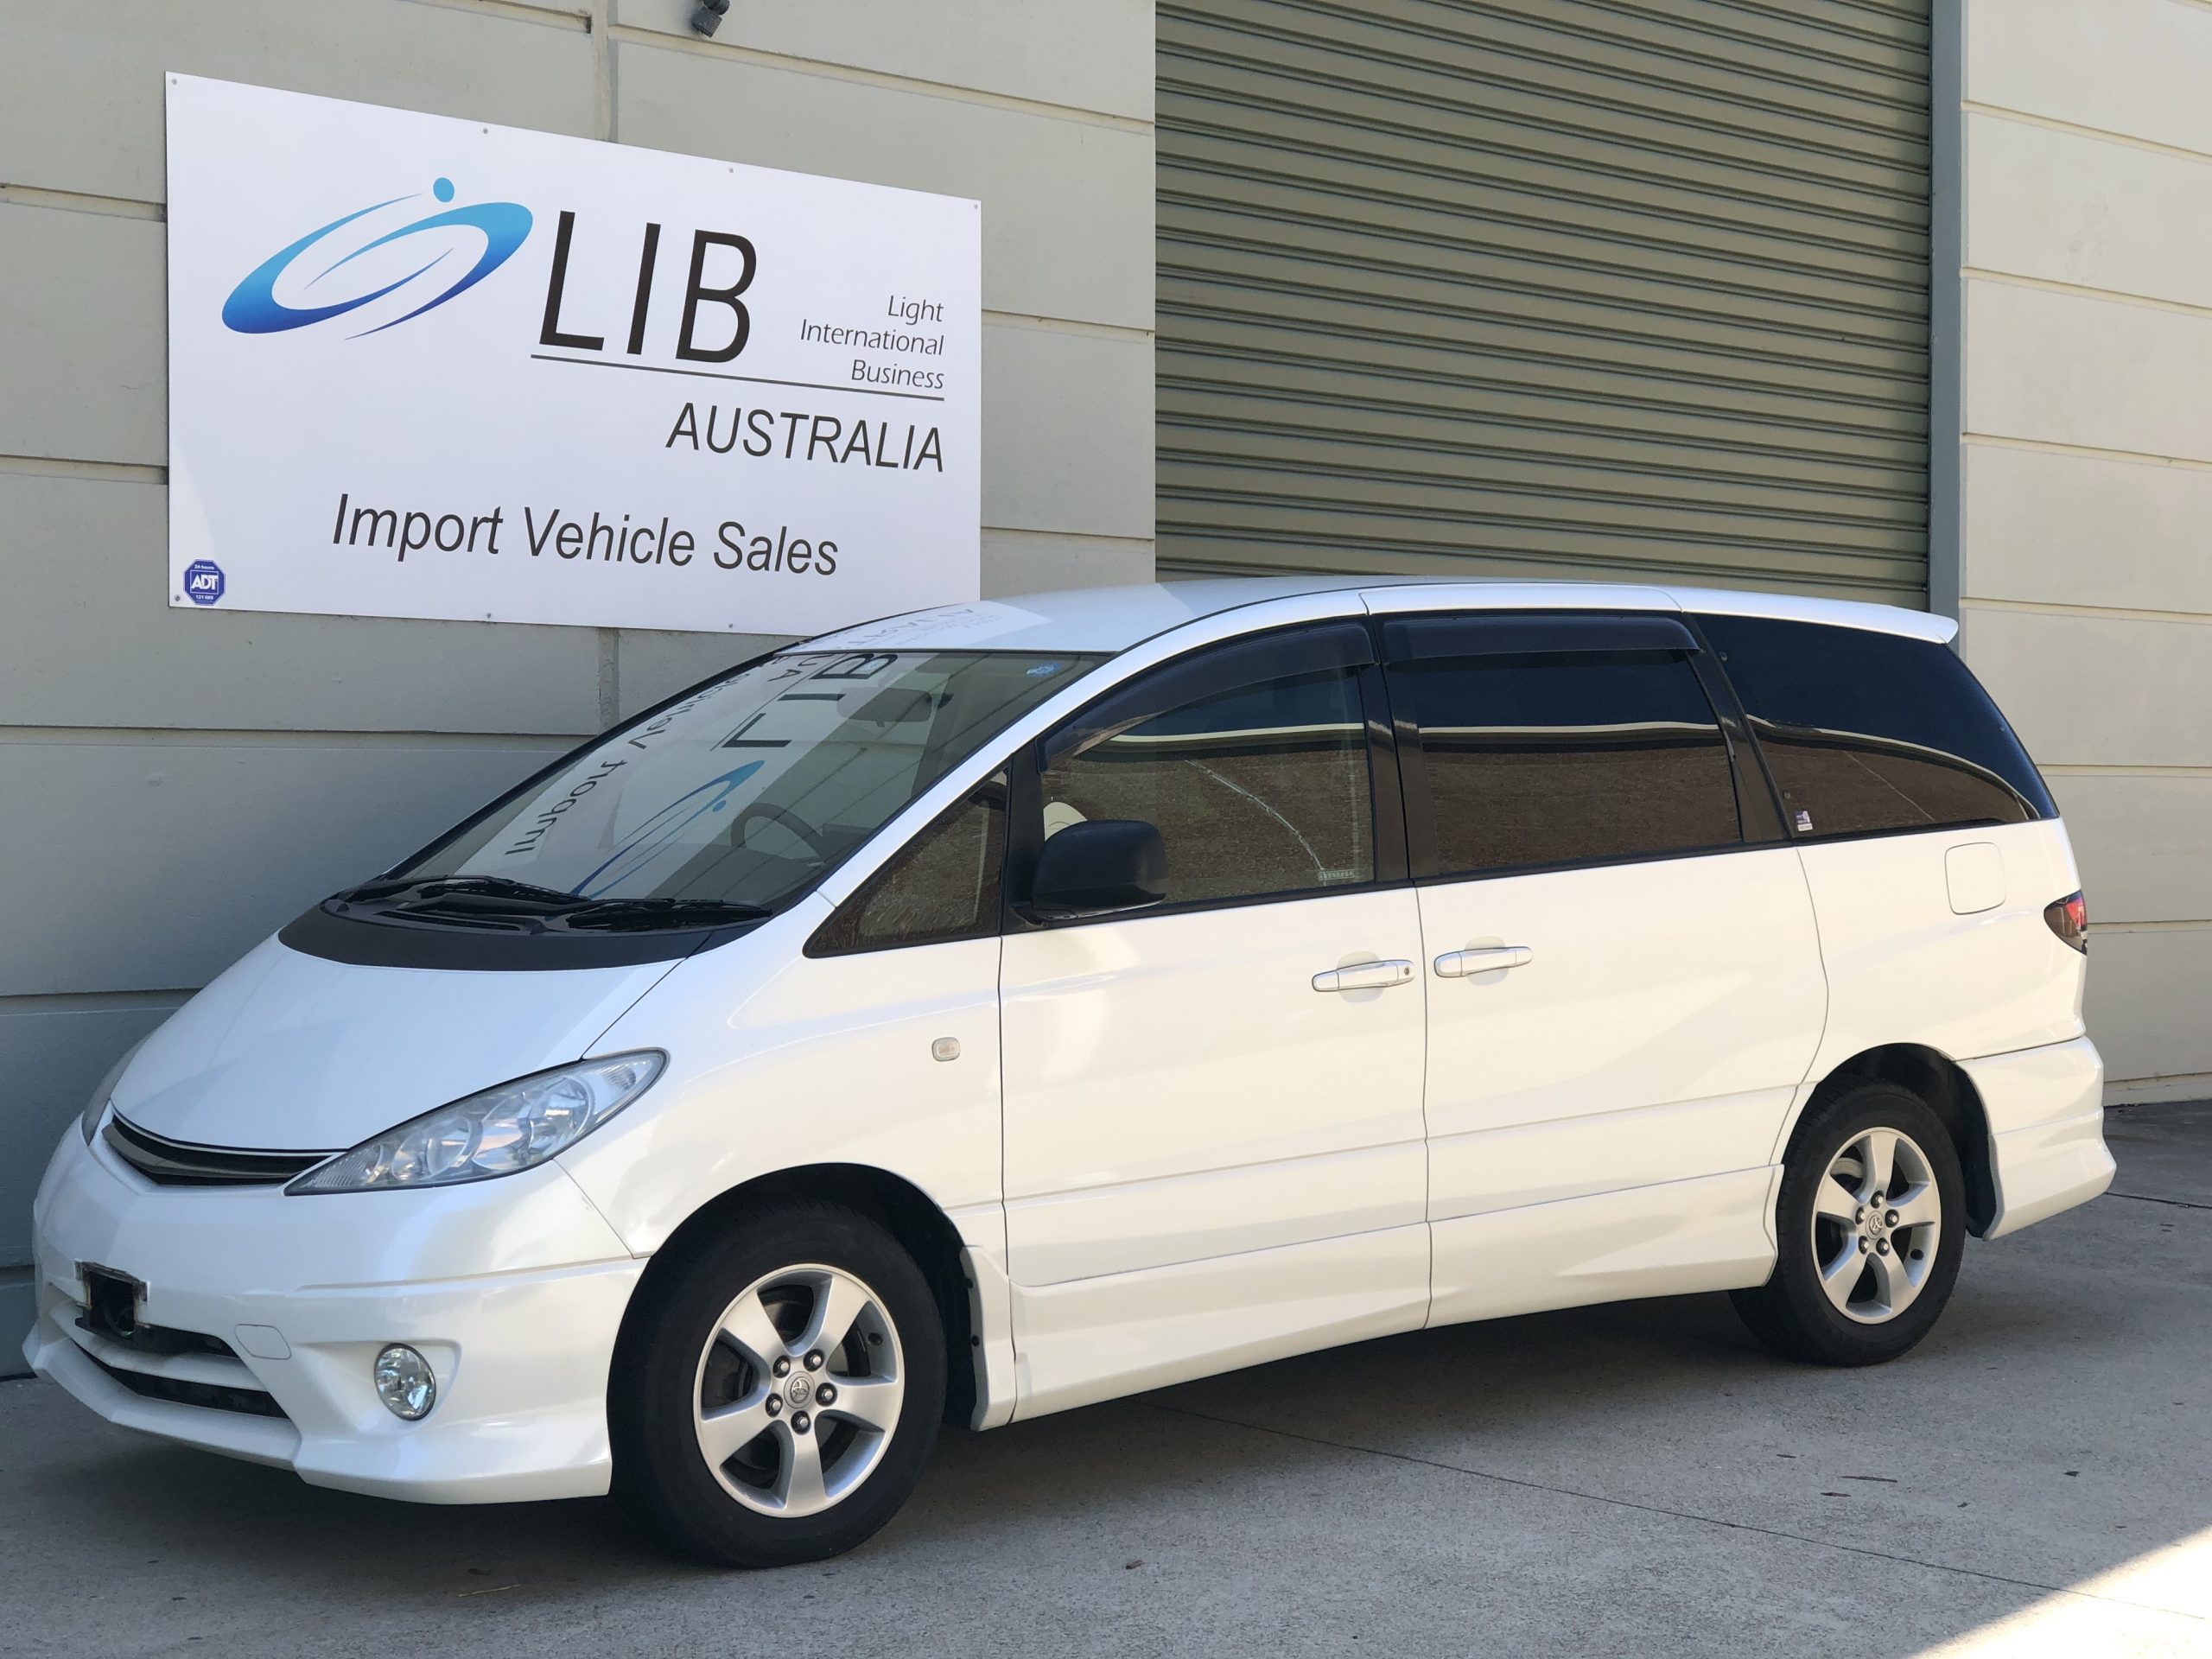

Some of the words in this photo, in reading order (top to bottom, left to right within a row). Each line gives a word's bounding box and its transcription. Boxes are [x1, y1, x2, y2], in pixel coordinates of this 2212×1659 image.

[538, 210, 757, 364] LIB
[887, 295, 944, 326] Light
[800, 319, 944, 356] International
[851, 359, 944, 390] Business
[664, 402, 944, 473] AUSTRALIA
[333, 493, 504, 563] Import
[524, 506, 695, 567] Vehicle
[713, 521, 838, 576] Sales
[191, 574, 219, 590] ADT
